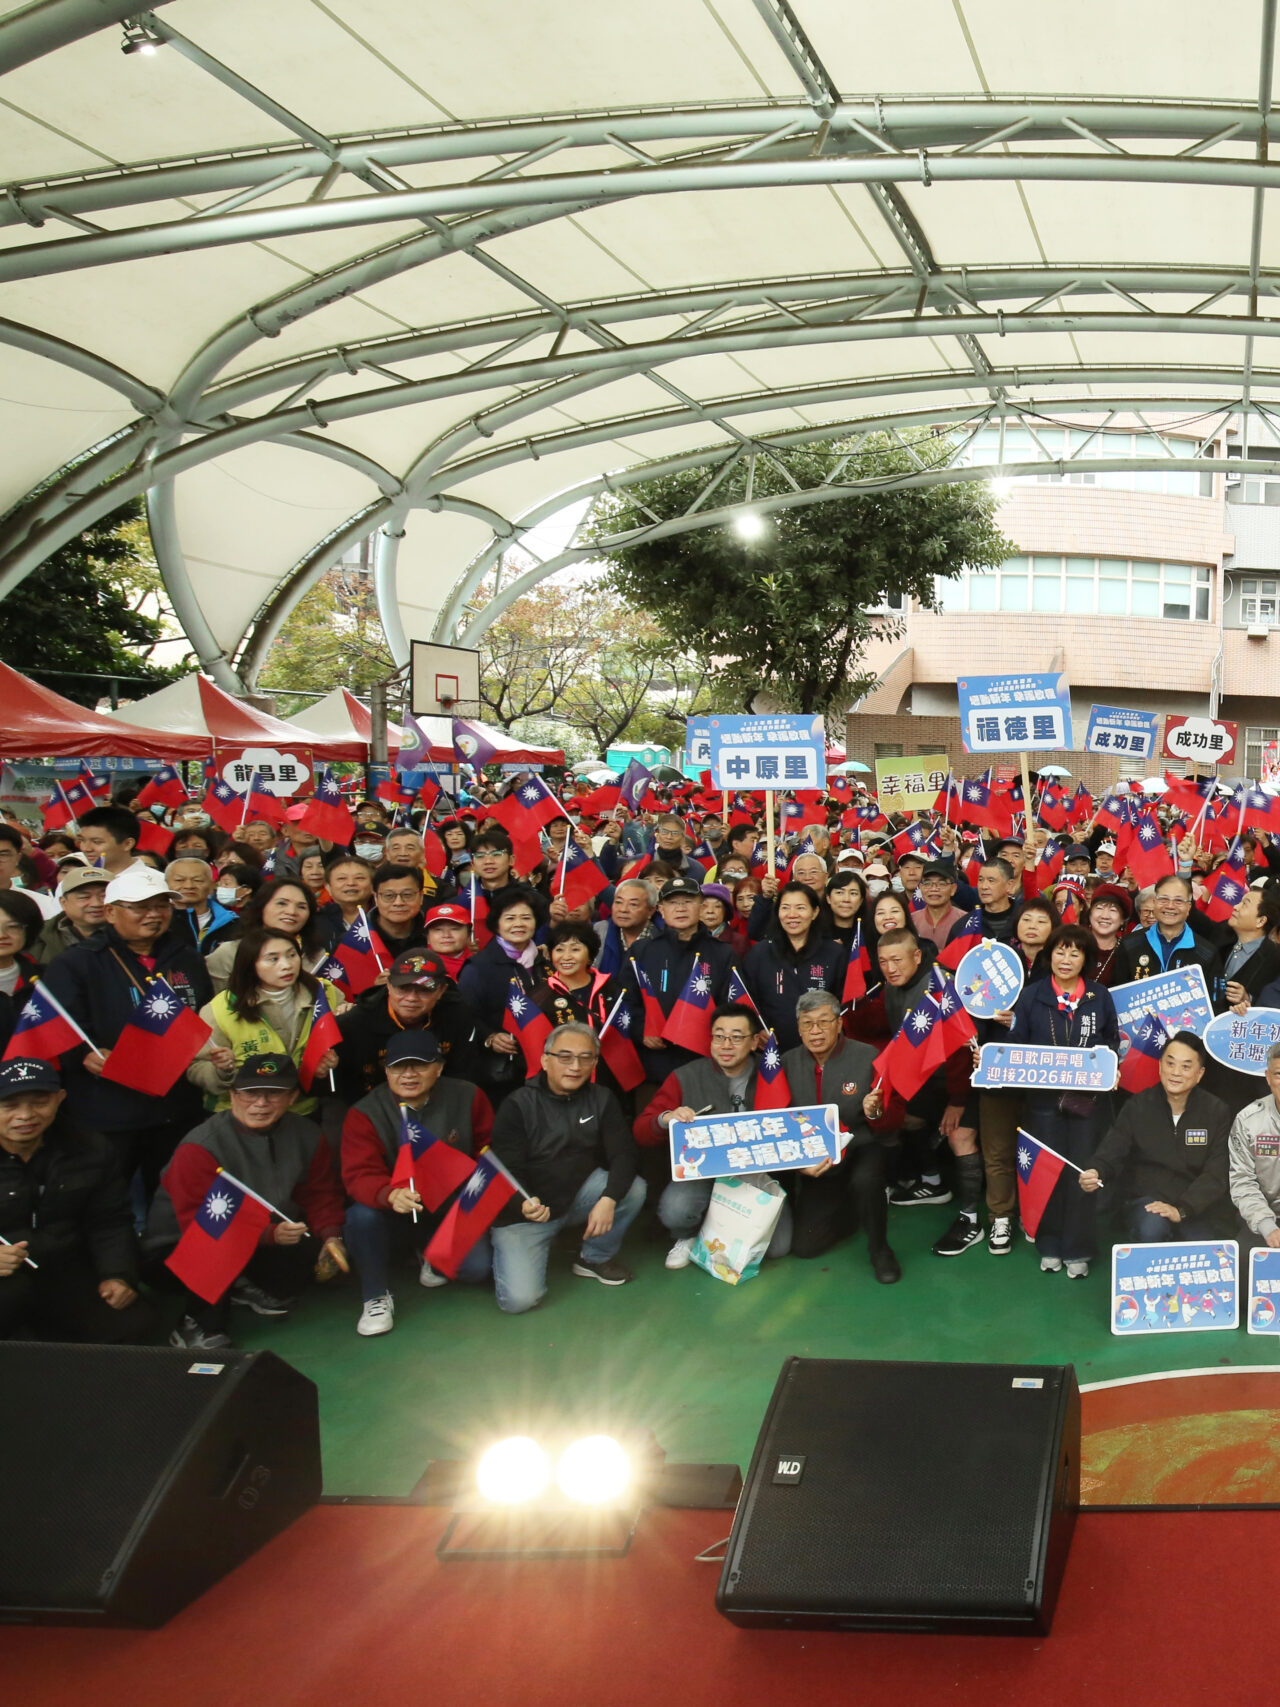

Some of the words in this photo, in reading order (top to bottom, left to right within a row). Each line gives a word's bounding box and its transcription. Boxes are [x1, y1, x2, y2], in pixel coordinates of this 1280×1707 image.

[976, 715, 1056, 742] 福德里
[1095, 732, 1145, 752] 成功里
[1176, 731, 1224, 750] 成功里
[234, 764, 298, 782] 龍昌里
[726, 755, 808, 780] 中原里
[881, 771, 946, 795] 幸福里
[1079, 1015, 1091, 1047] 葉明月
[1009, 1050, 1085, 1068] 國歌同齊唱
[986, 1066, 1104, 1087] 迎接2026新展望
[684, 1116, 788, 1149] 運動新年
[726, 1135, 830, 1169] 幸福啟程
[1119, 1273, 1176, 1291] 運動新年
